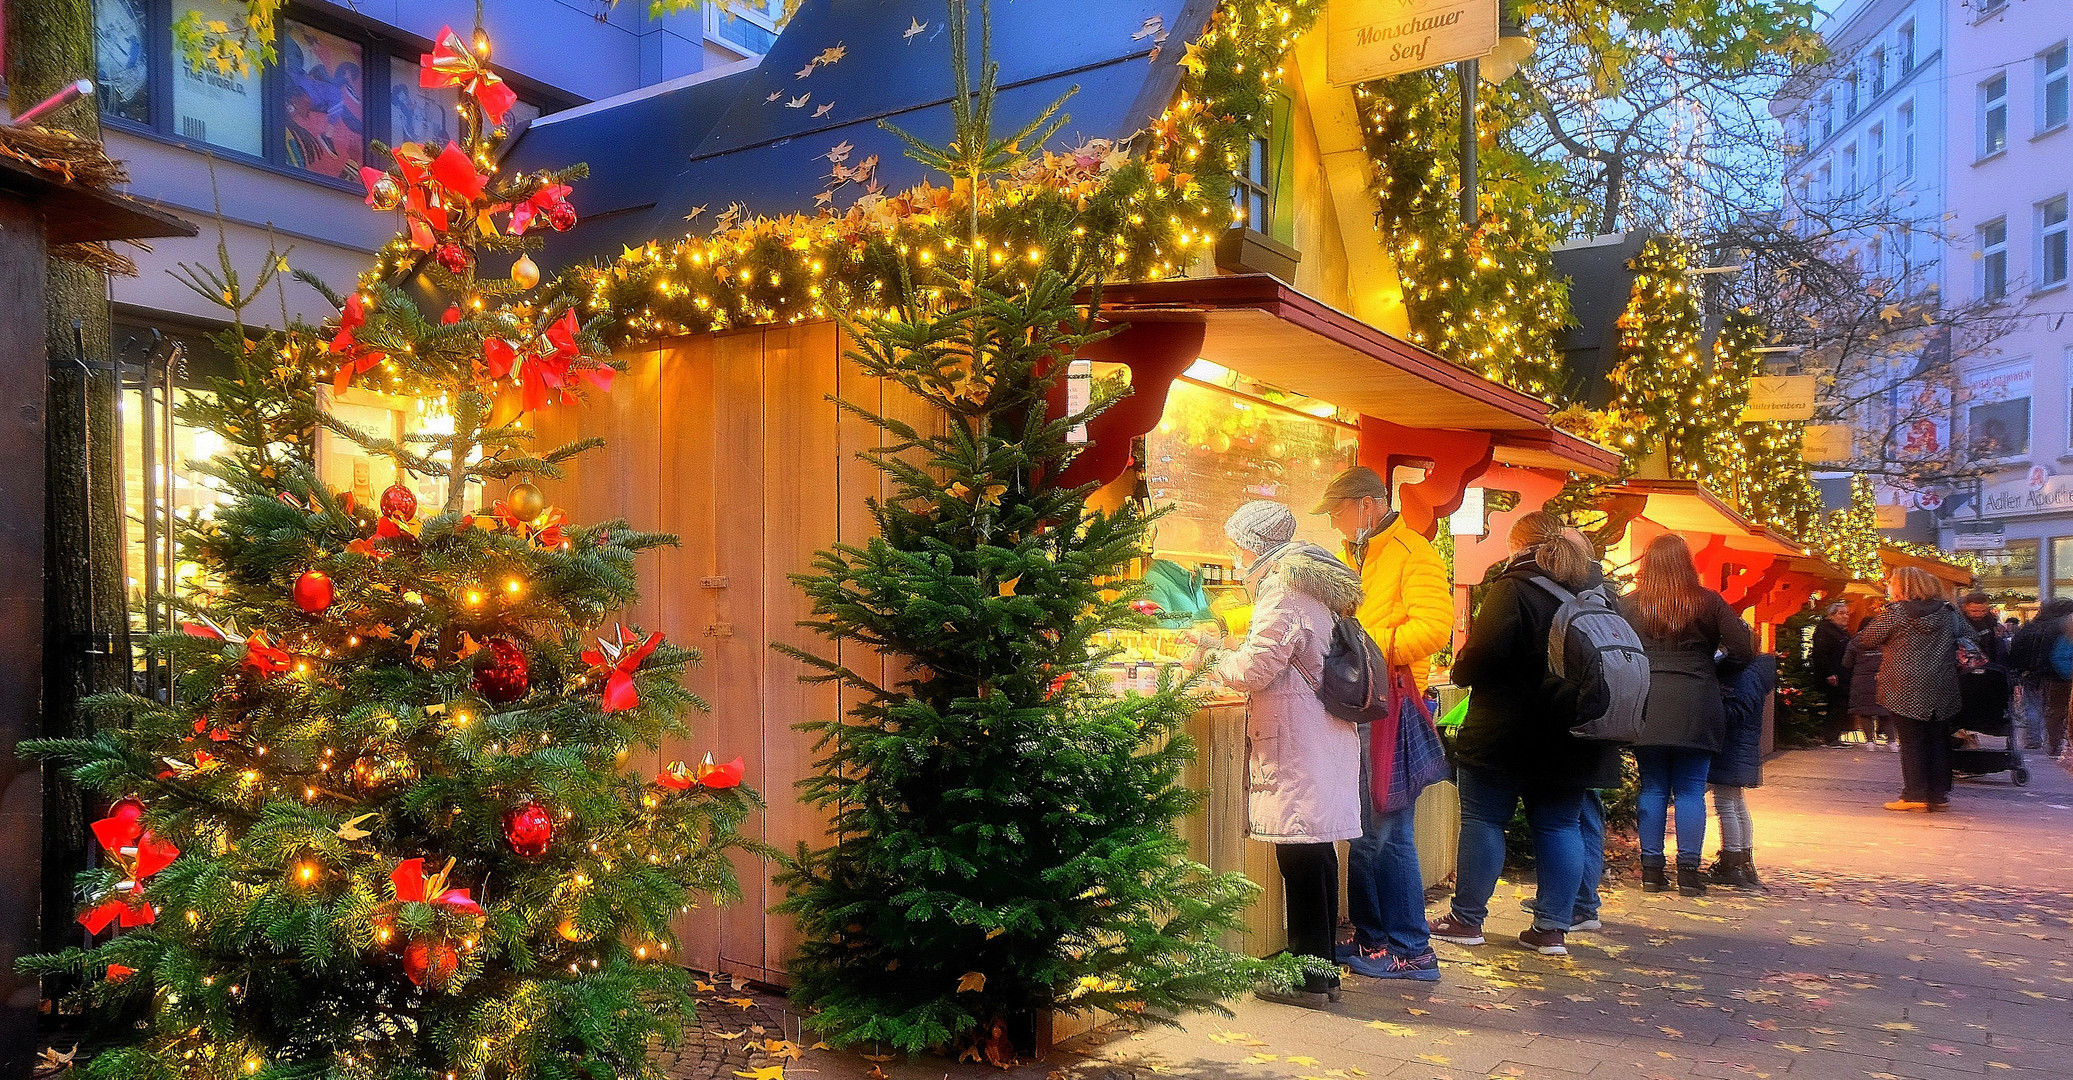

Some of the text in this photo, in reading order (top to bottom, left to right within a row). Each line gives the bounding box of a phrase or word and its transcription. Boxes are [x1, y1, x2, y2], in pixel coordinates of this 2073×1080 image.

[1356, 9, 1465, 47] Monschauer
[1389, 36, 1432, 62] Senf
[1985, 491, 2020, 511] Adler
